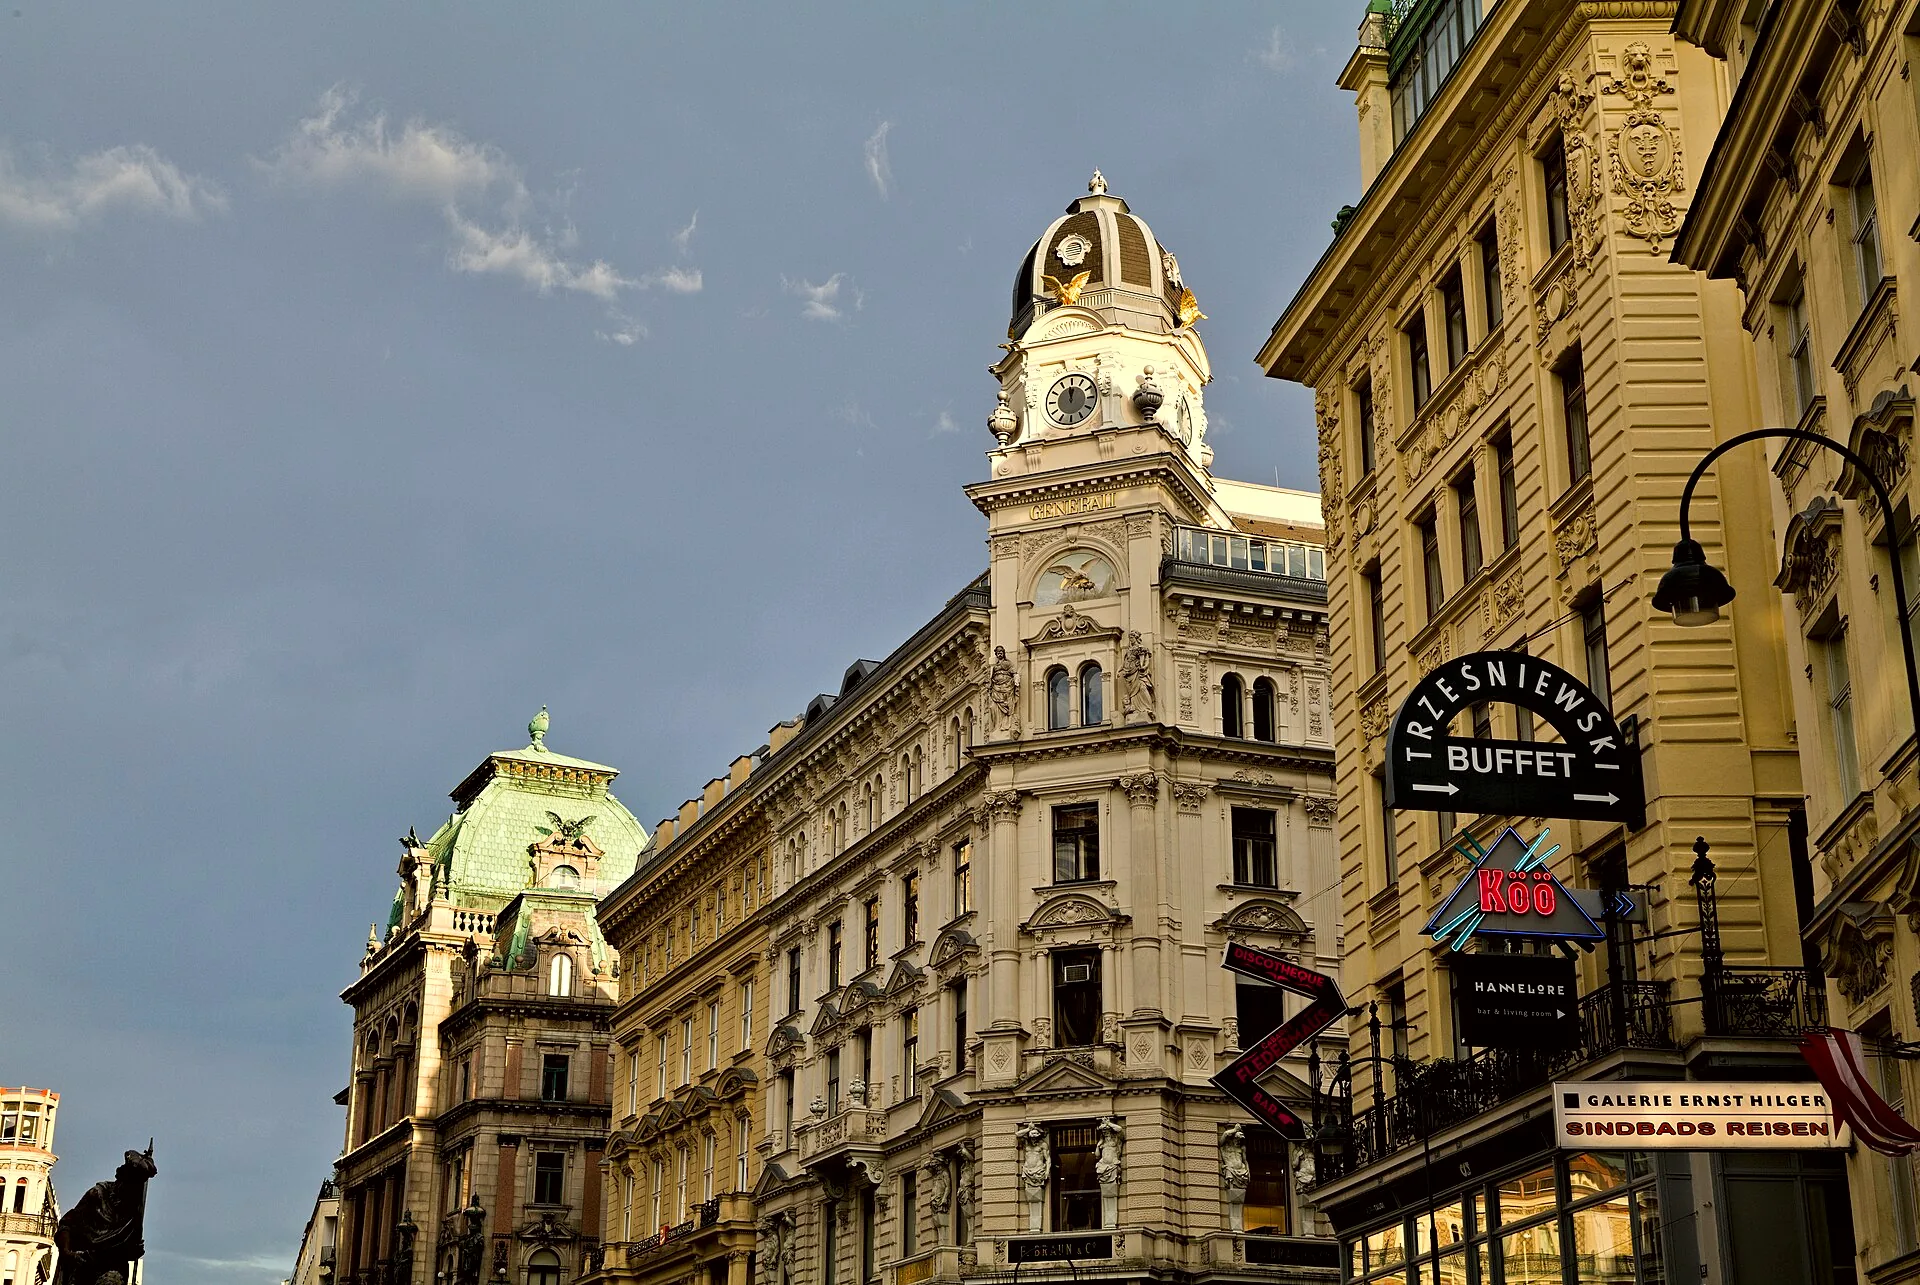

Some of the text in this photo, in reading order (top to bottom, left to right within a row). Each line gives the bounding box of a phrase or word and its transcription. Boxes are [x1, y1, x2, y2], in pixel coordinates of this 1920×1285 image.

[1030, 493, 1116, 520] GENERALI
[1447, 745, 1576, 778] BUFFET
[1233, 947, 1325, 988] DISCOTHEQUE
[1474, 981, 1565, 996] HANNELORE
[1477, 1007, 1490, 1015] bar
[1503, 1008, 1528, 1017] living
[1235, 1007, 1330, 1084] FLEDERMAUS
[1252, 1091, 1277, 1115] BAR
[1587, 1095, 1826, 1107] GALERIE ERNST HILGER
[1565, 1121, 1829, 1136] SINDBADS REISEN
